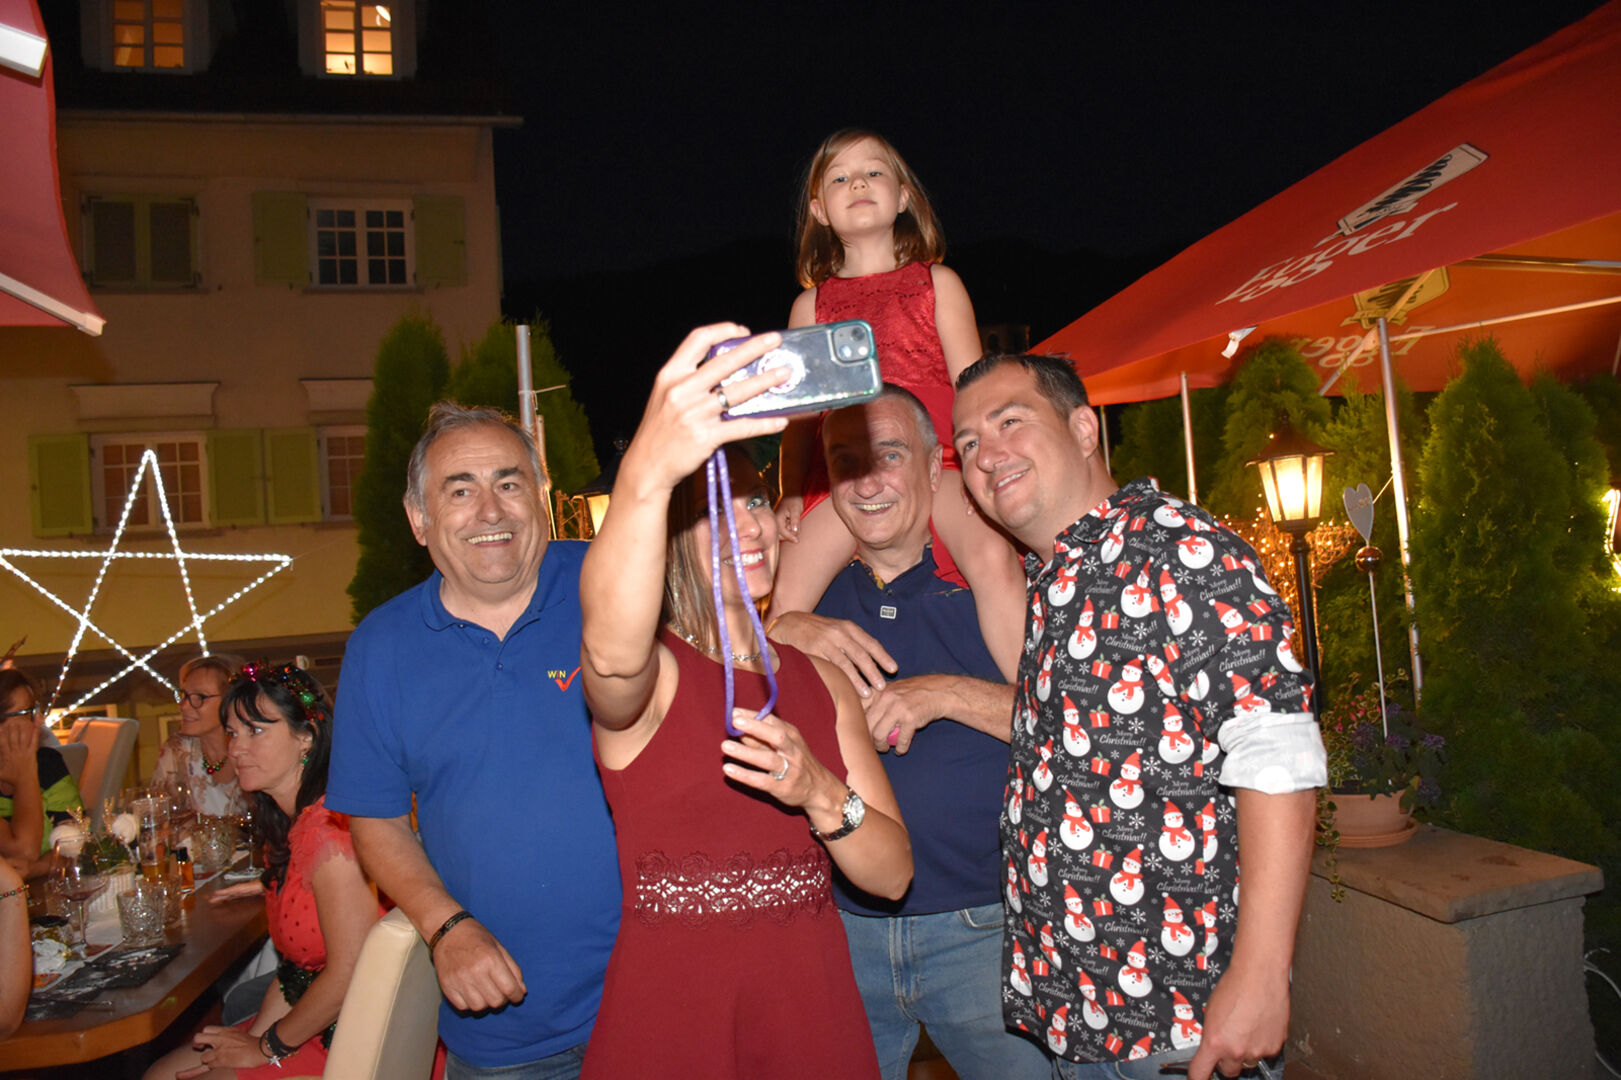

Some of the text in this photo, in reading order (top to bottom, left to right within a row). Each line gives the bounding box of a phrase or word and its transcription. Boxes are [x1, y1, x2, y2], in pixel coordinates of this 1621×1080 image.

[1214, 202, 1459, 305] Egger
[1200, 577, 1242, 601] Christmas!!
[1208, 579, 1228, 589] Merry
[1183, 647, 1201, 659] Merry
[1232, 648, 1251, 659] Merry
[1219, 649, 1266, 672] Christmas!!
[1099, 733, 1147, 747] Christmas!!
[1115, 729, 1134, 738] Merry
[1057, 774, 1100, 789] Christmas!!
[1156, 785, 1202, 797] Christmas!!
[1101, 829, 1147, 842] Christmas!!
[1117, 824, 1134, 834] Merry
[1156, 881, 1203, 893] Christmas!!
[1104, 921, 1150, 937] Christmas!!
[1163, 974, 1208, 988] Christmas!!
[1115, 1012, 1159, 1031] Christmas!!
